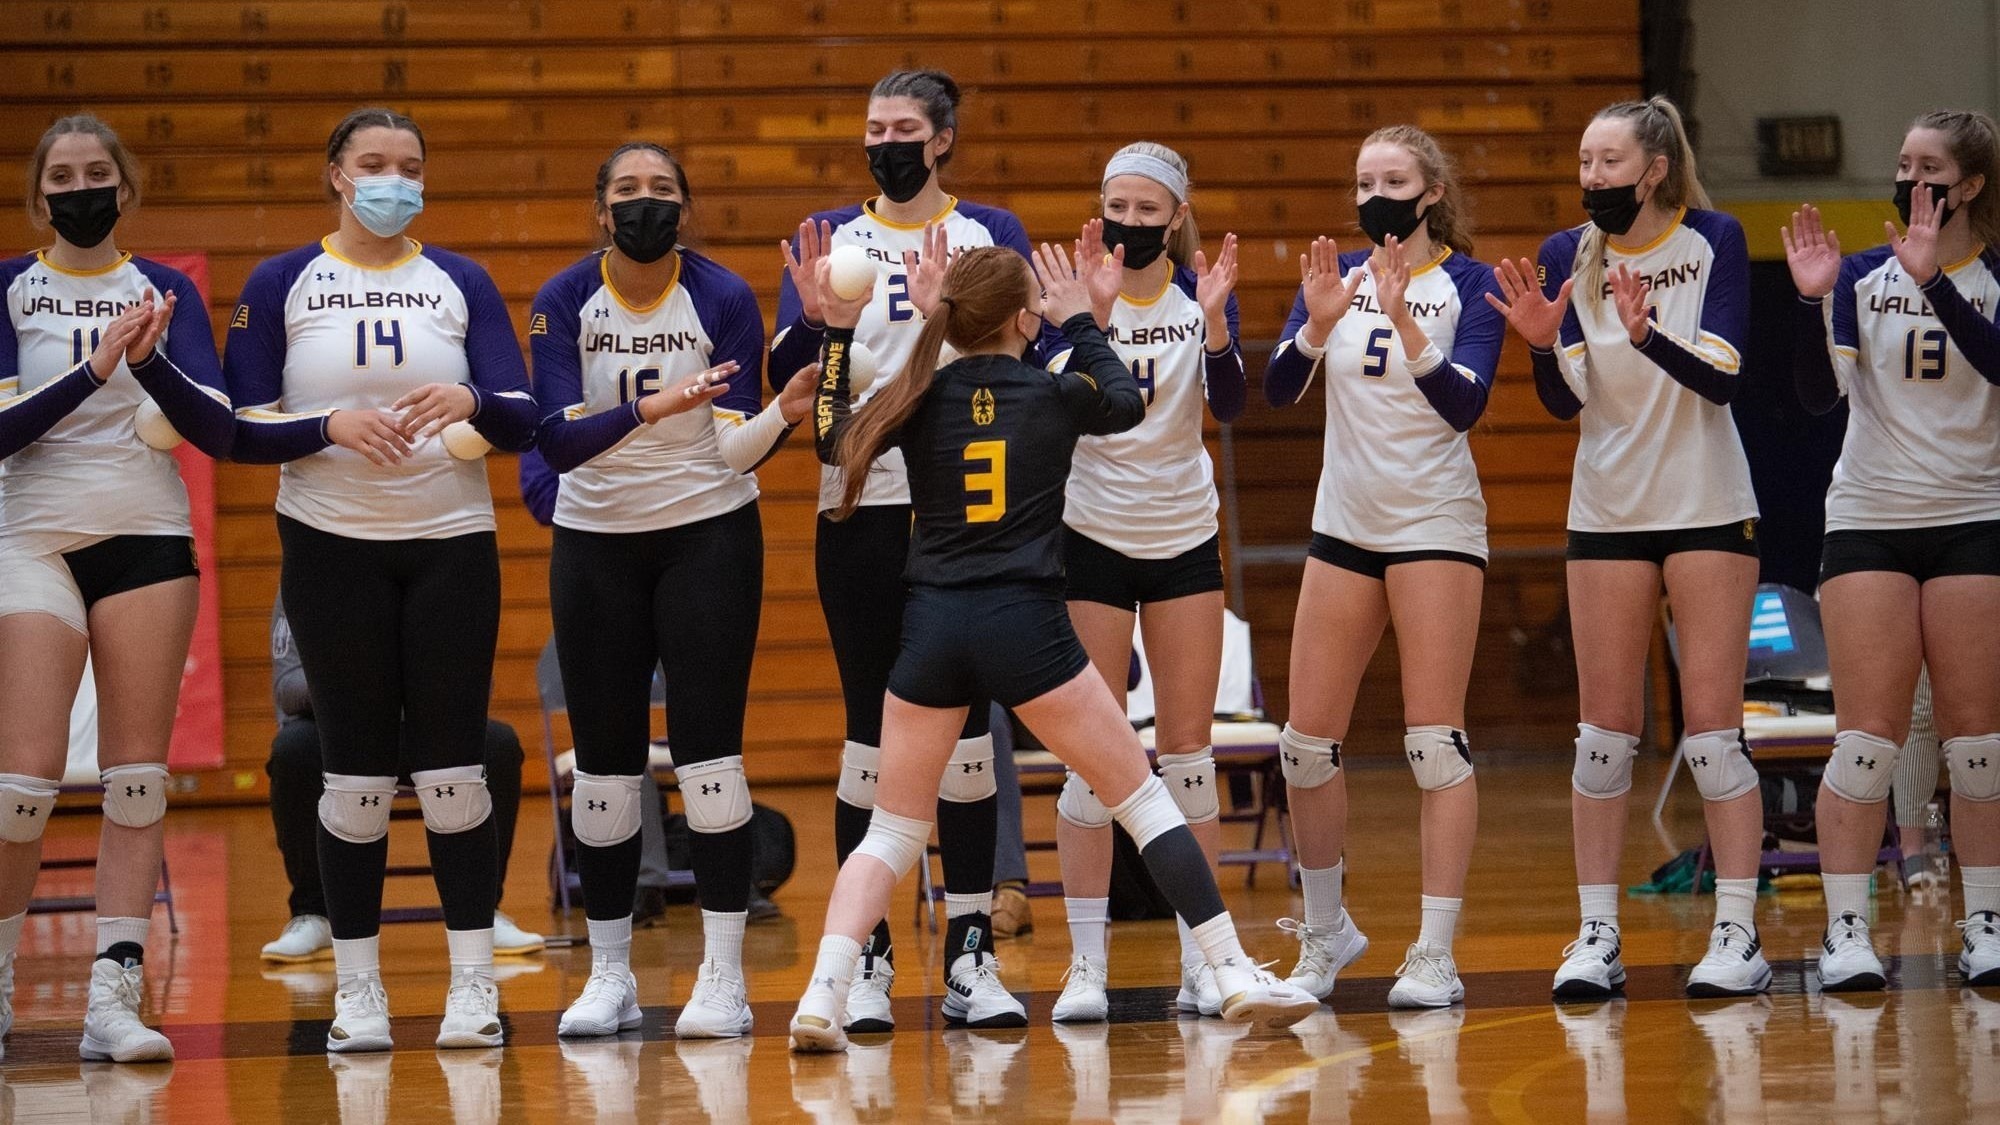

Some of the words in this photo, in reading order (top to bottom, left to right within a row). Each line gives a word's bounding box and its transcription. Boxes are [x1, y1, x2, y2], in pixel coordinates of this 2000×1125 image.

[22, 296, 141, 318] UALBAN
[306, 291, 442, 311] UALBANY
[353, 316, 408, 370] 14
[585, 331, 697, 355] UALBANY
[823, 342, 845, 390] DANE
[1360, 325, 1394, 381] 5
[1901, 326, 1951, 383] 13
[963, 439, 1007, 524] 3
